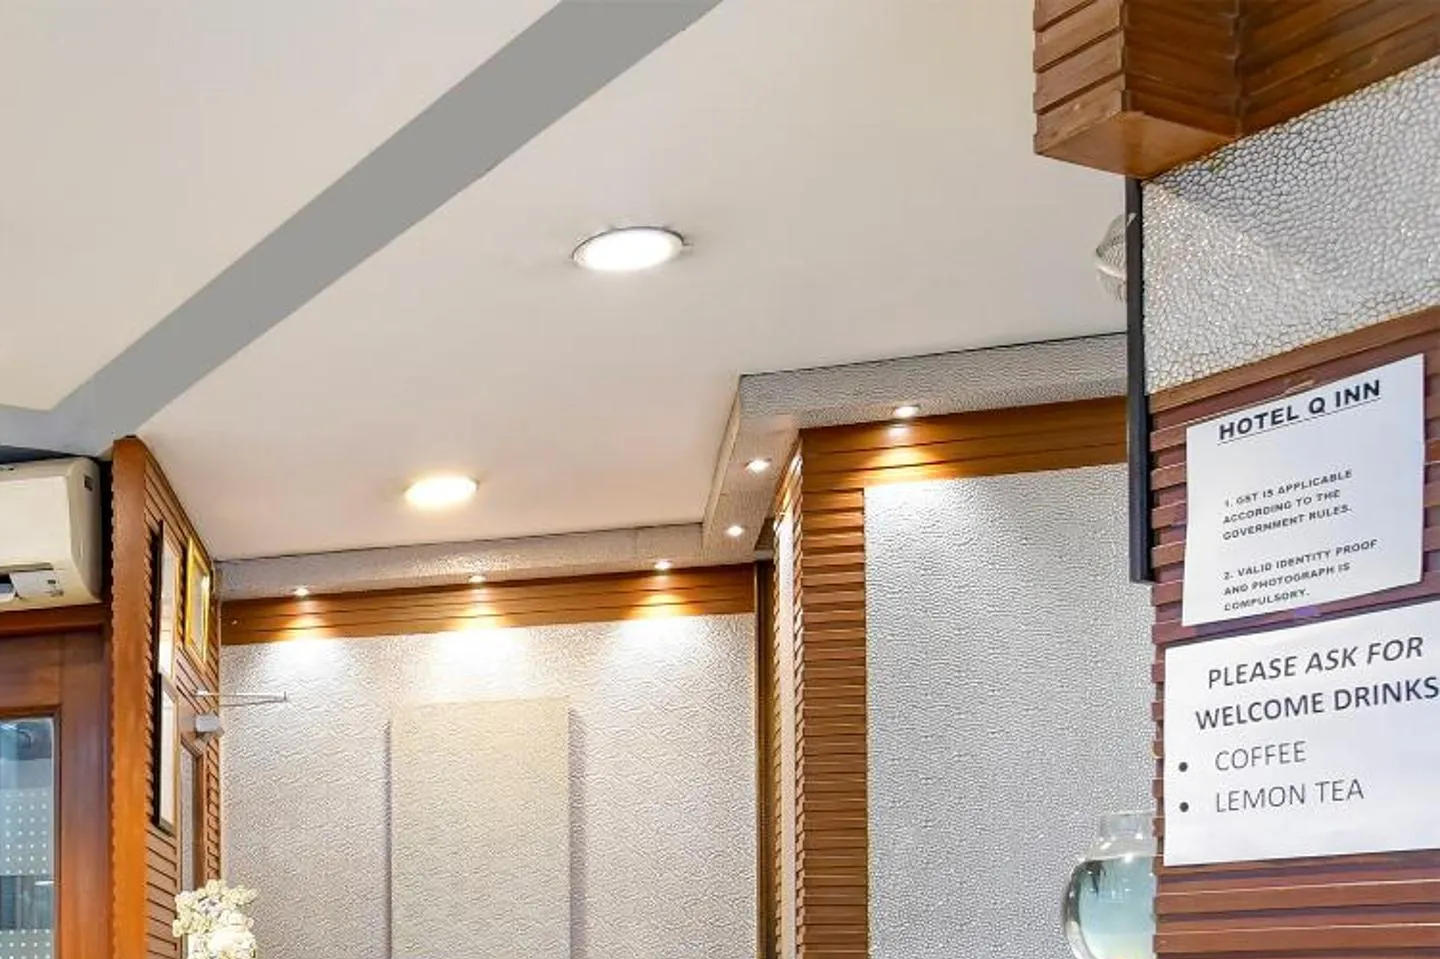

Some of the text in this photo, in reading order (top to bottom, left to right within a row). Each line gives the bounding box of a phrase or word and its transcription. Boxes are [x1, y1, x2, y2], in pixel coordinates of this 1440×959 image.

[1219, 379, 1381, 441] HOTEL Q INN
[1236, 492, 1258, 506] GST
[1262, 488, 1274, 499] IS
[1277, 469, 1353, 495] APPLICABLE
[1222, 503, 1353, 541] GOVERNMENT RULES.
[1223, 489, 1341, 525] ACCORDING TO THE
[1237, 562, 1273, 578] VALID
[1275, 549, 1332, 570] IDENTITY
[1335, 538, 1380, 557] PROOF
[1223, 562, 1351, 596] AND PHOTOGRAPH IS
[1223, 588, 1311, 611] COMPULSORY.
[1208, 636, 1425, 689] PLEASE ASK FOR
[1195, 676, 1440, 731] WELCOME DRINKS
[1215, 740, 1308, 772] COFFEE
[1215, 778, 1365, 813] LEMON TEA
